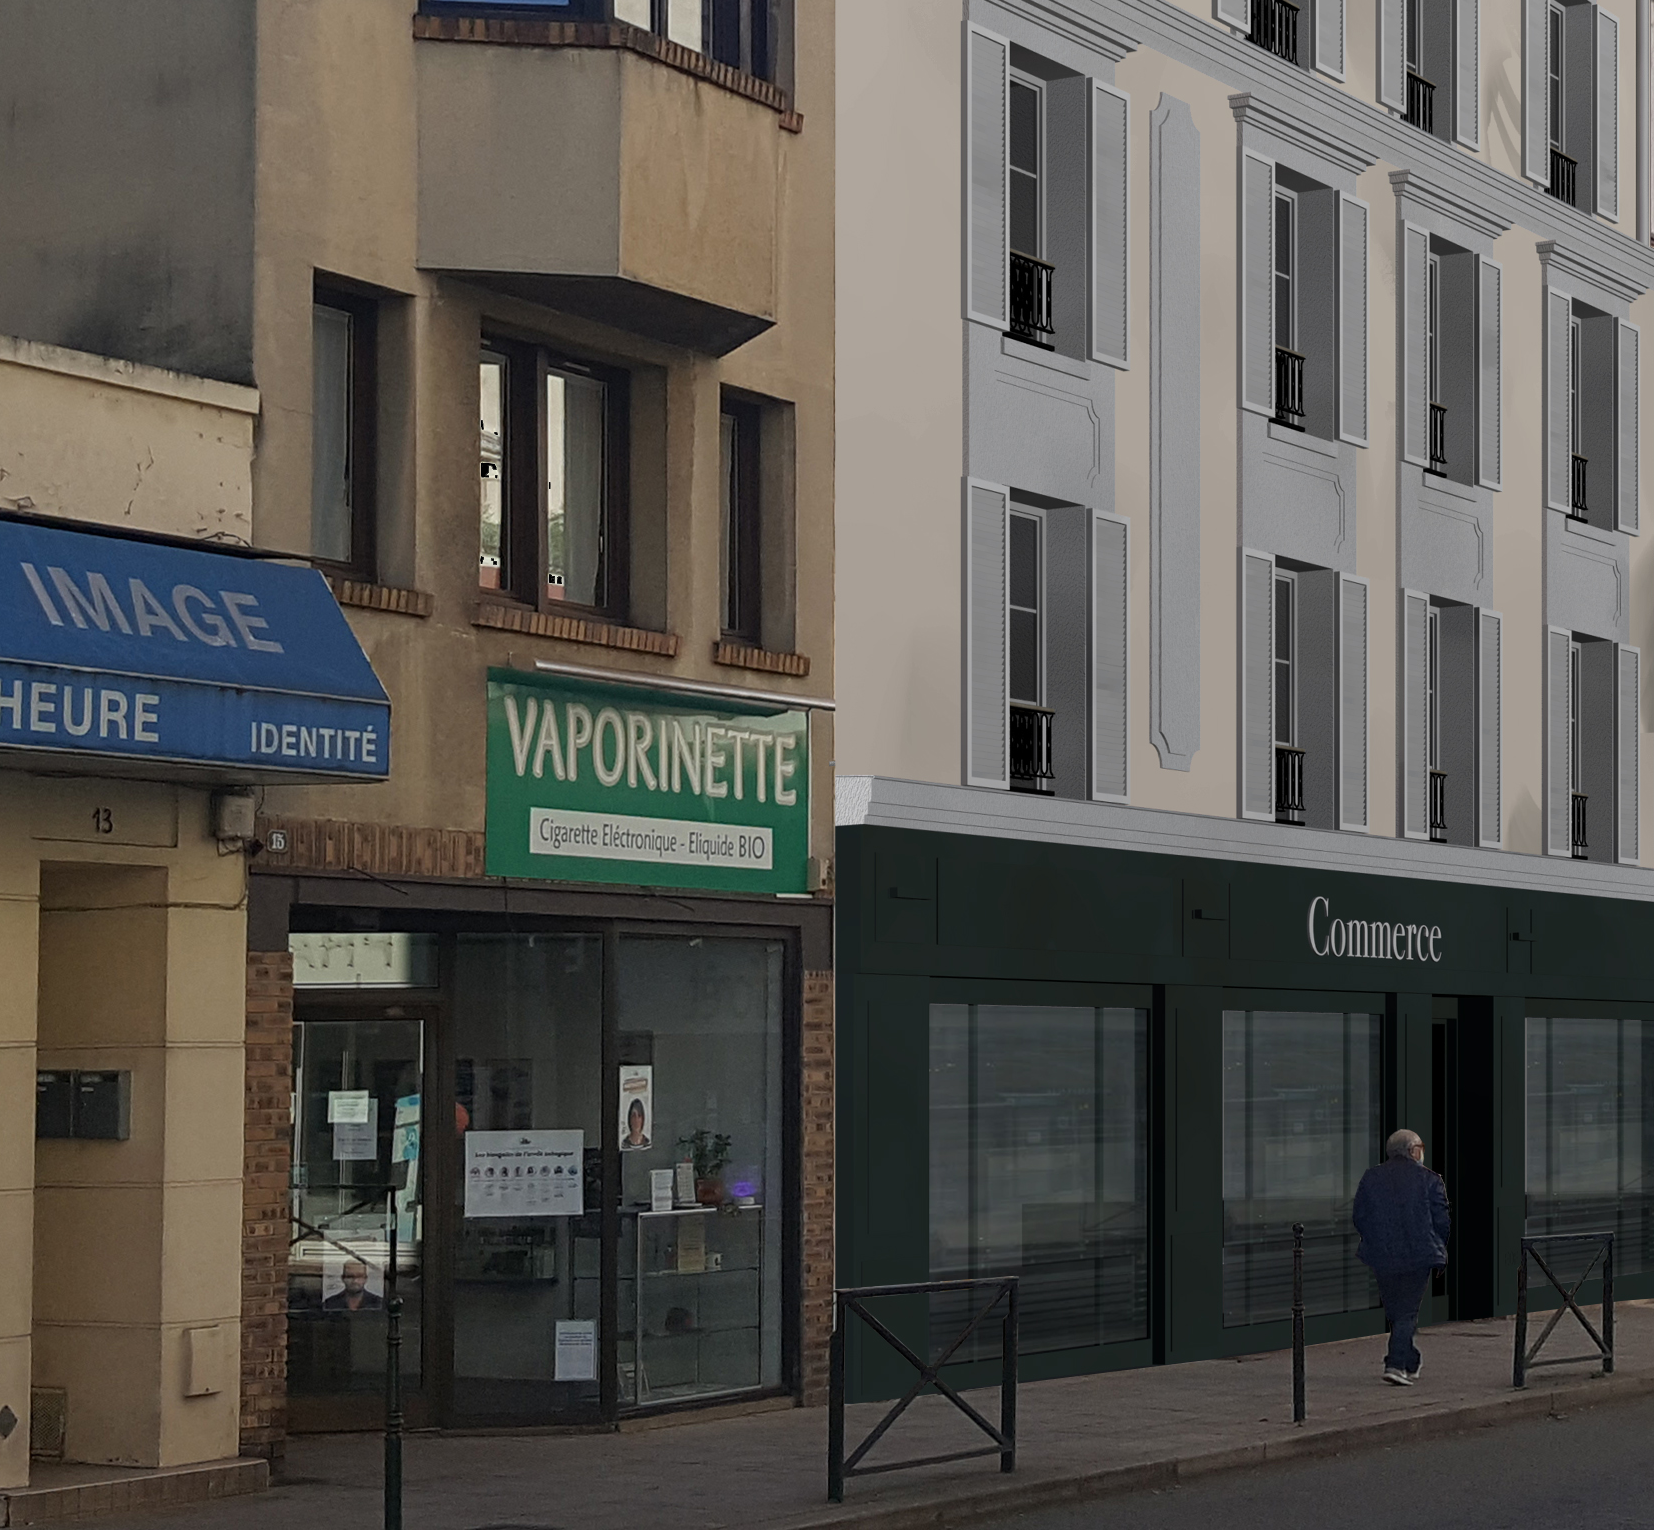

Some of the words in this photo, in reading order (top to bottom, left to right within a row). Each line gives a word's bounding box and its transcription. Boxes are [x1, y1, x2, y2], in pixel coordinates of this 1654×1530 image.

[20, 561, 285, 654] IMAGE
[250, 722, 378, 763] IDENTITÉ
[503, 693, 797, 807] VAPORINETTE
[91, 806, 114, 834] 13
[271, 832, 286, 850] 15
[539, 818, 598, 849] Cigarette
[602, 823, 677, 858] Eléctronique
[688, 831, 735, 861] Eliquide
[738, 836, 766, 860] BIO
[1307, 895, 1443, 963] Commerce
